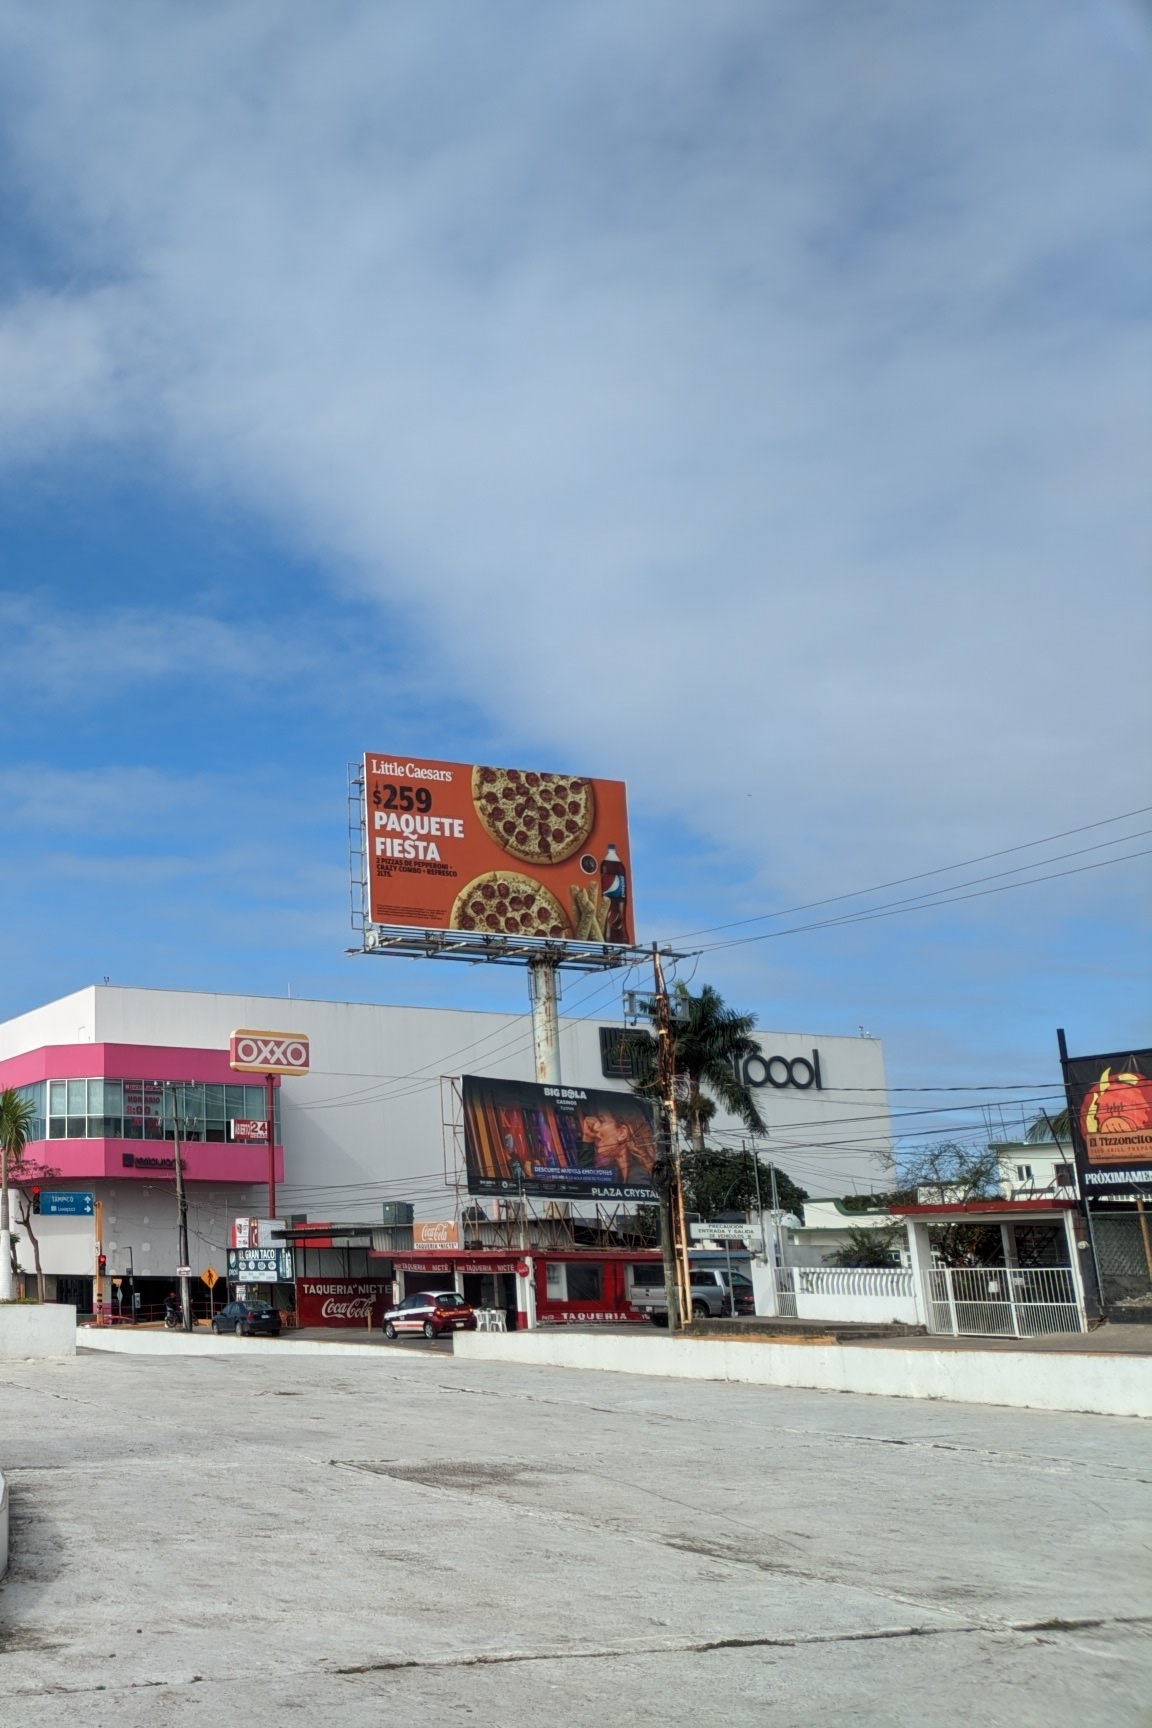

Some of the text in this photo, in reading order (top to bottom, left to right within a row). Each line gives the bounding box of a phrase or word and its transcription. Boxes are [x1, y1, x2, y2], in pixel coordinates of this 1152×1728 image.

[372, 759, 452, 782] Little Caesars
[373, 780, 432, 813] $259
[374, 811, 464, 840] PAQUETE
[376, 837, 441, 862] FIESTA
[399, 866, 421, 874] COMBO
[426, 868, 458, 877] REFRESCO
[414, 861, 448, 870] PEPPERONI
[238, 1039, 306, 1066] OXXO
[544, 1088, 587, 1100] BIG BOLA
[250, 1122, 267, 1134] 24
[1090, 1134, 1152, 1147] El Tizzoncito
[592, 1187, 660, 1199] PLAZA CRYSTAL
[245, 1250, 260, 1260] GRAN
[260, 1250, 275, 1260] TACO
[303, 1284, 353, 1295] TAQUERIA
